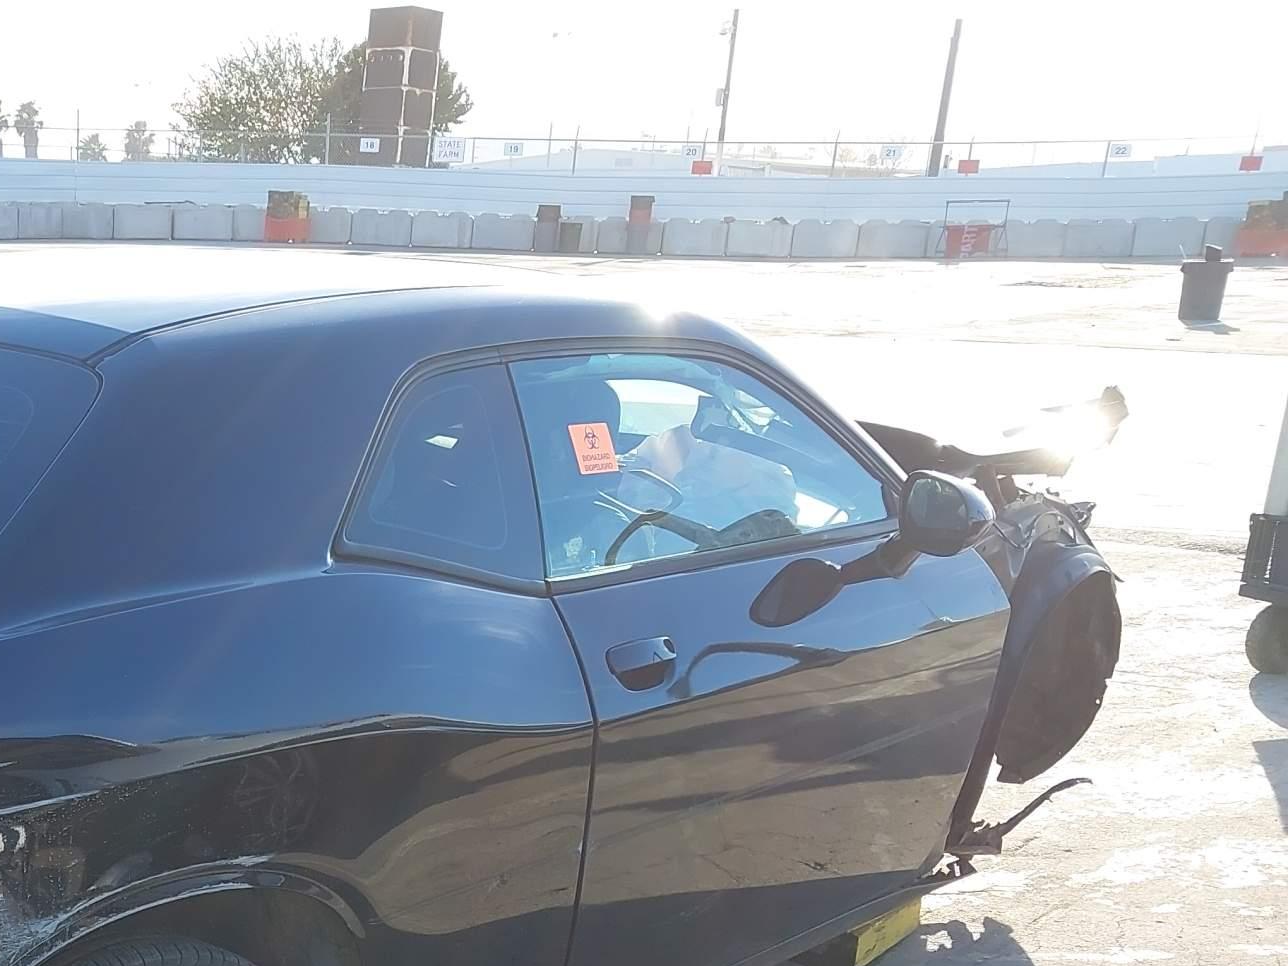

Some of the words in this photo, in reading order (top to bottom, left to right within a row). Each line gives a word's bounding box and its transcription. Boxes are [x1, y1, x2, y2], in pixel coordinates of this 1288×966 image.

[365, 142, 375, 150] 18
[438, 140, 461, 149] STATE
[509, 145, 519, 153] 19
[686, 148, 697, 156] 20
[886, 149, 896, 157] 21
[1115, 146, 1128, 155] 22
[438, 150, 460, 159] FARM
